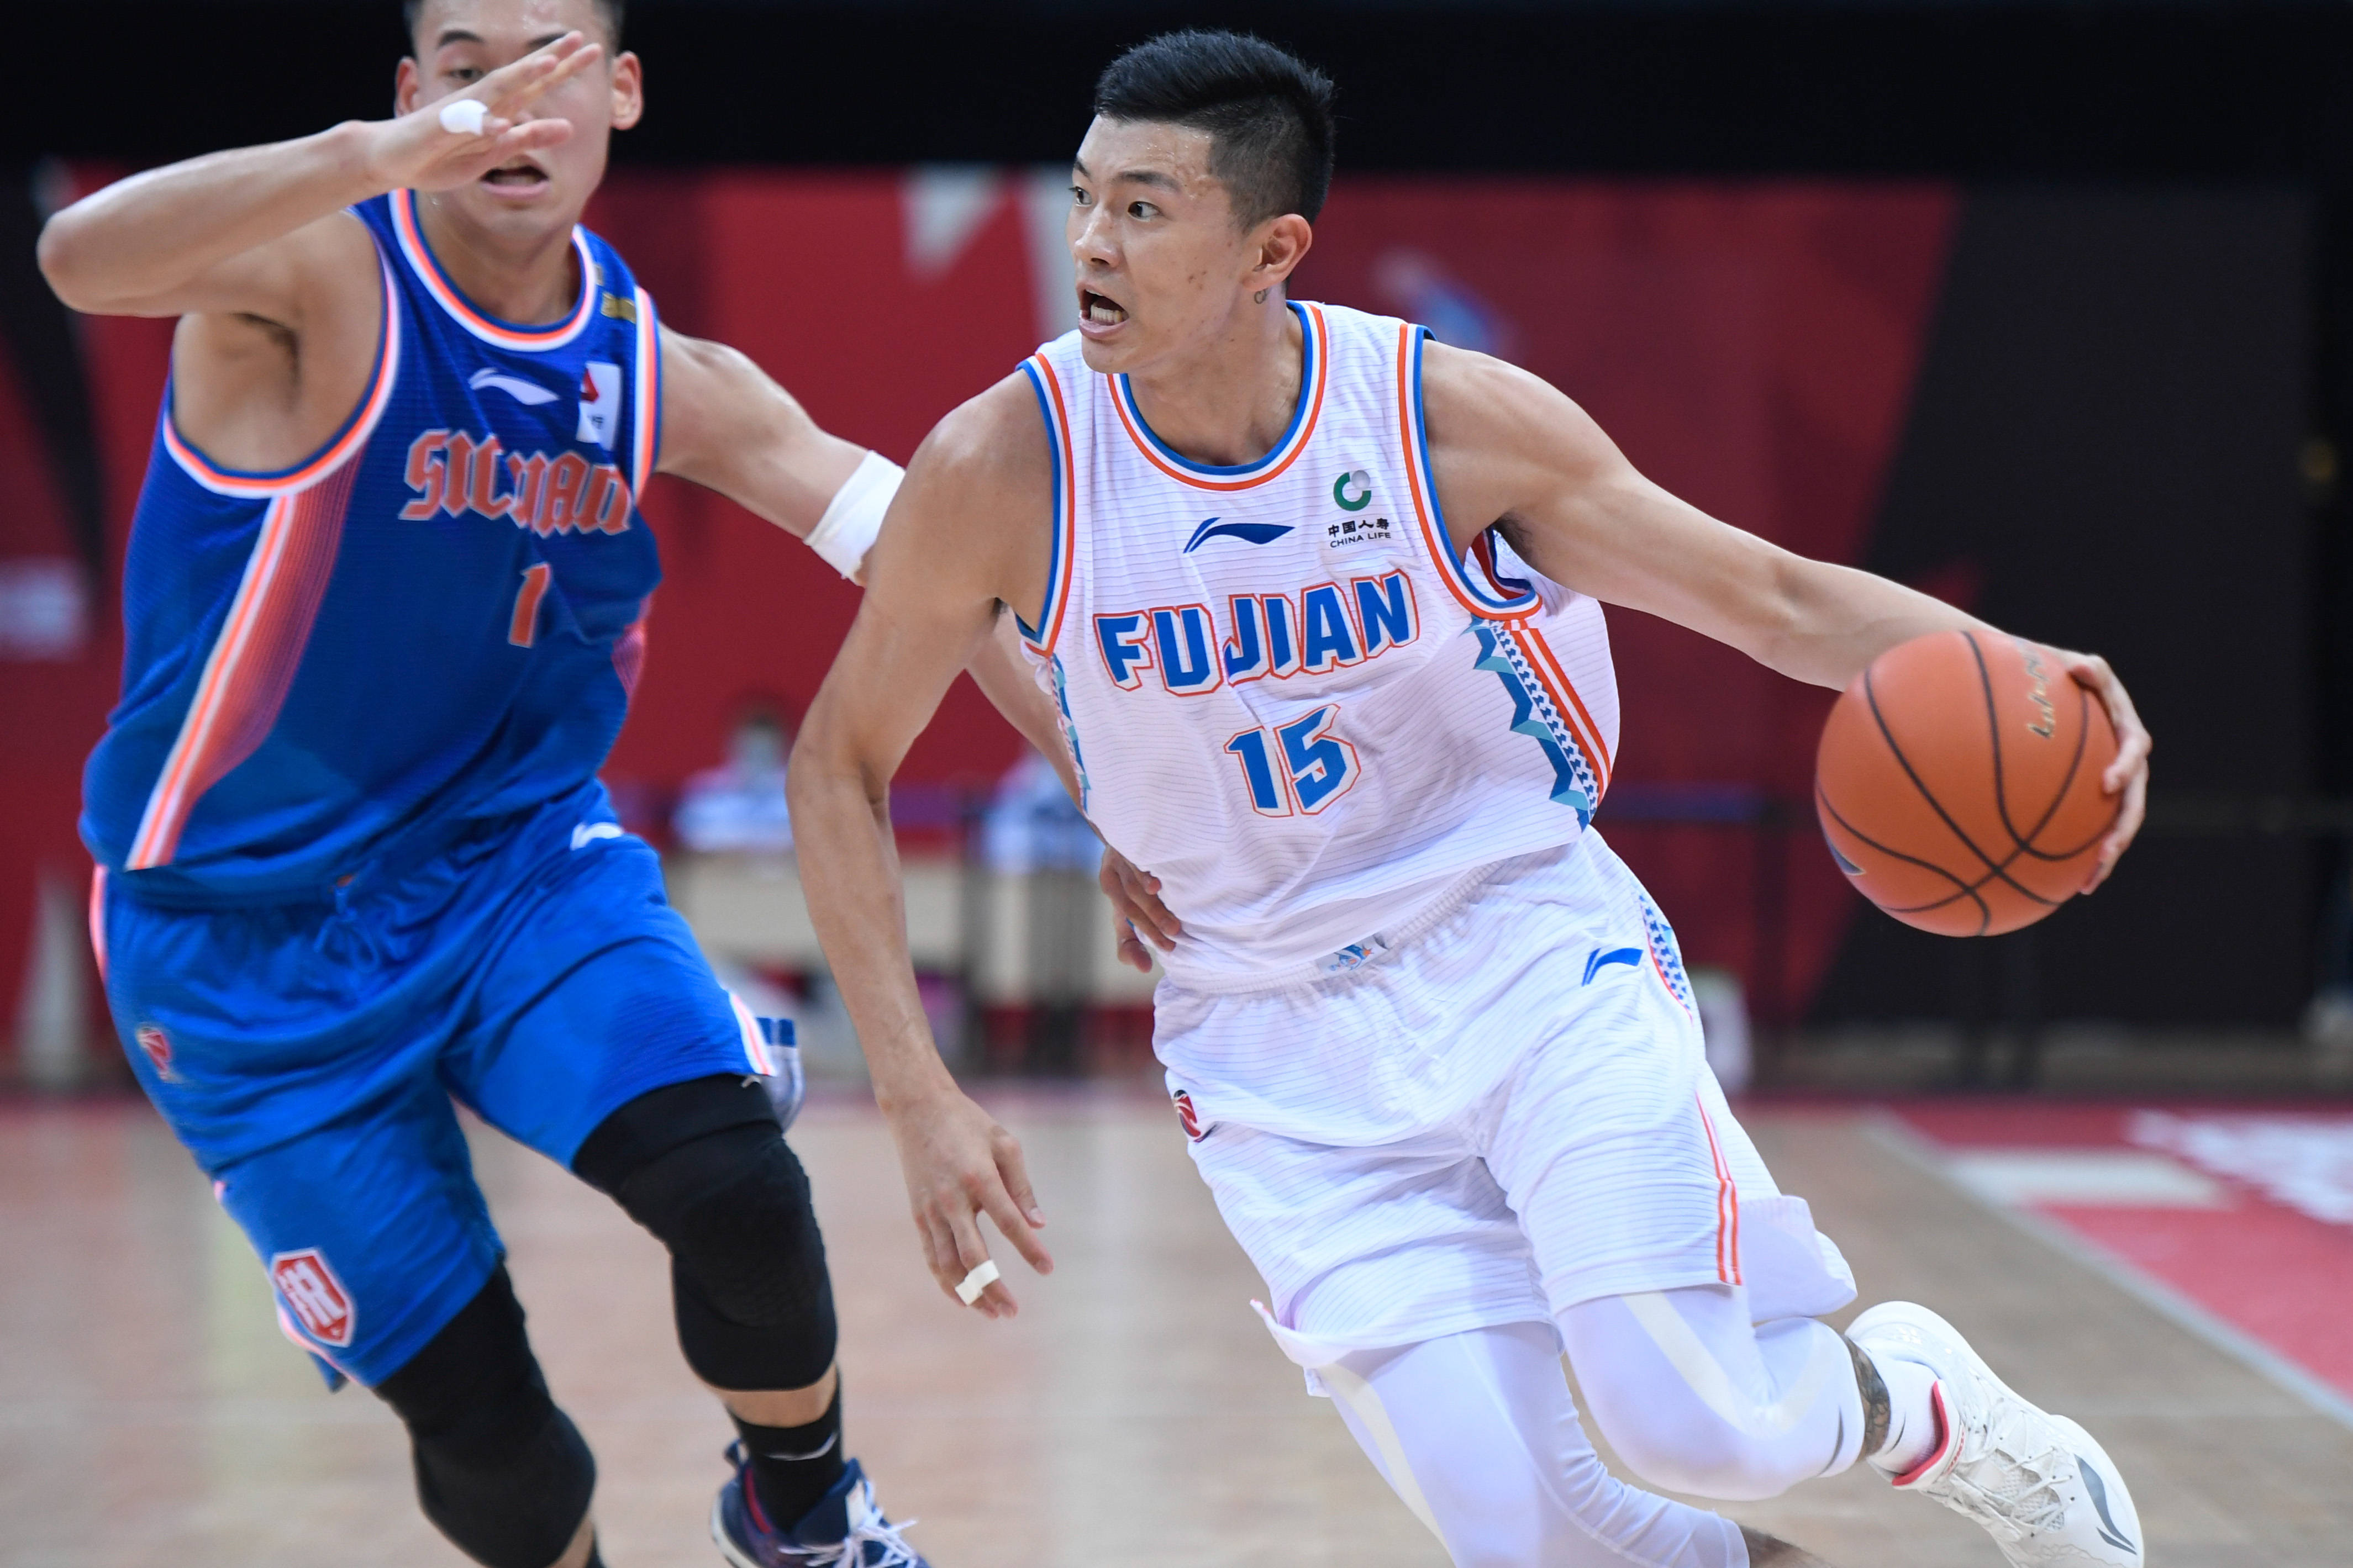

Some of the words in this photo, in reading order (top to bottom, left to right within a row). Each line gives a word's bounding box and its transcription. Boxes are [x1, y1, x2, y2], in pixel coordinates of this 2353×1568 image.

[1328, 518, 1389, 538] 中国人寿
[1330, 535, 1364, 548] CHINA
[508, 561, 551, 648] 1
[1093, 569, 1420, 696] FUJIAN
[1224, 703, 1361, 818] 15
